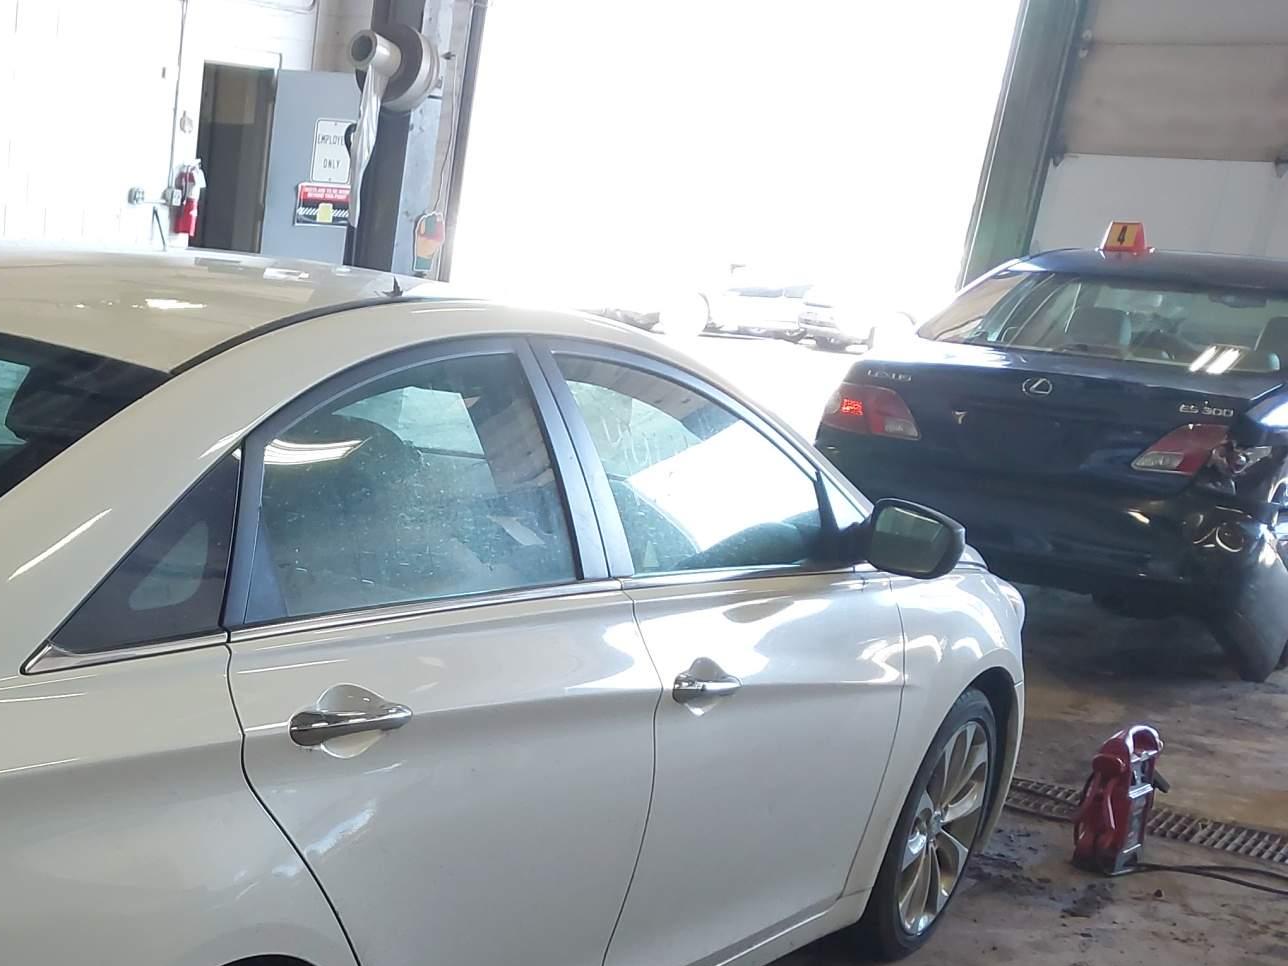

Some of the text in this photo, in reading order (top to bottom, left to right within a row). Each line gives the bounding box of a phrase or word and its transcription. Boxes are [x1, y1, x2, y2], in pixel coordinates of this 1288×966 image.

[317, 133, 345, 145] EMPLOYE
[322, 158, 341, 169] ONLY
[1116, 224, 1128, 245] 4
[1179, 404, 1234, 417] ES 300
